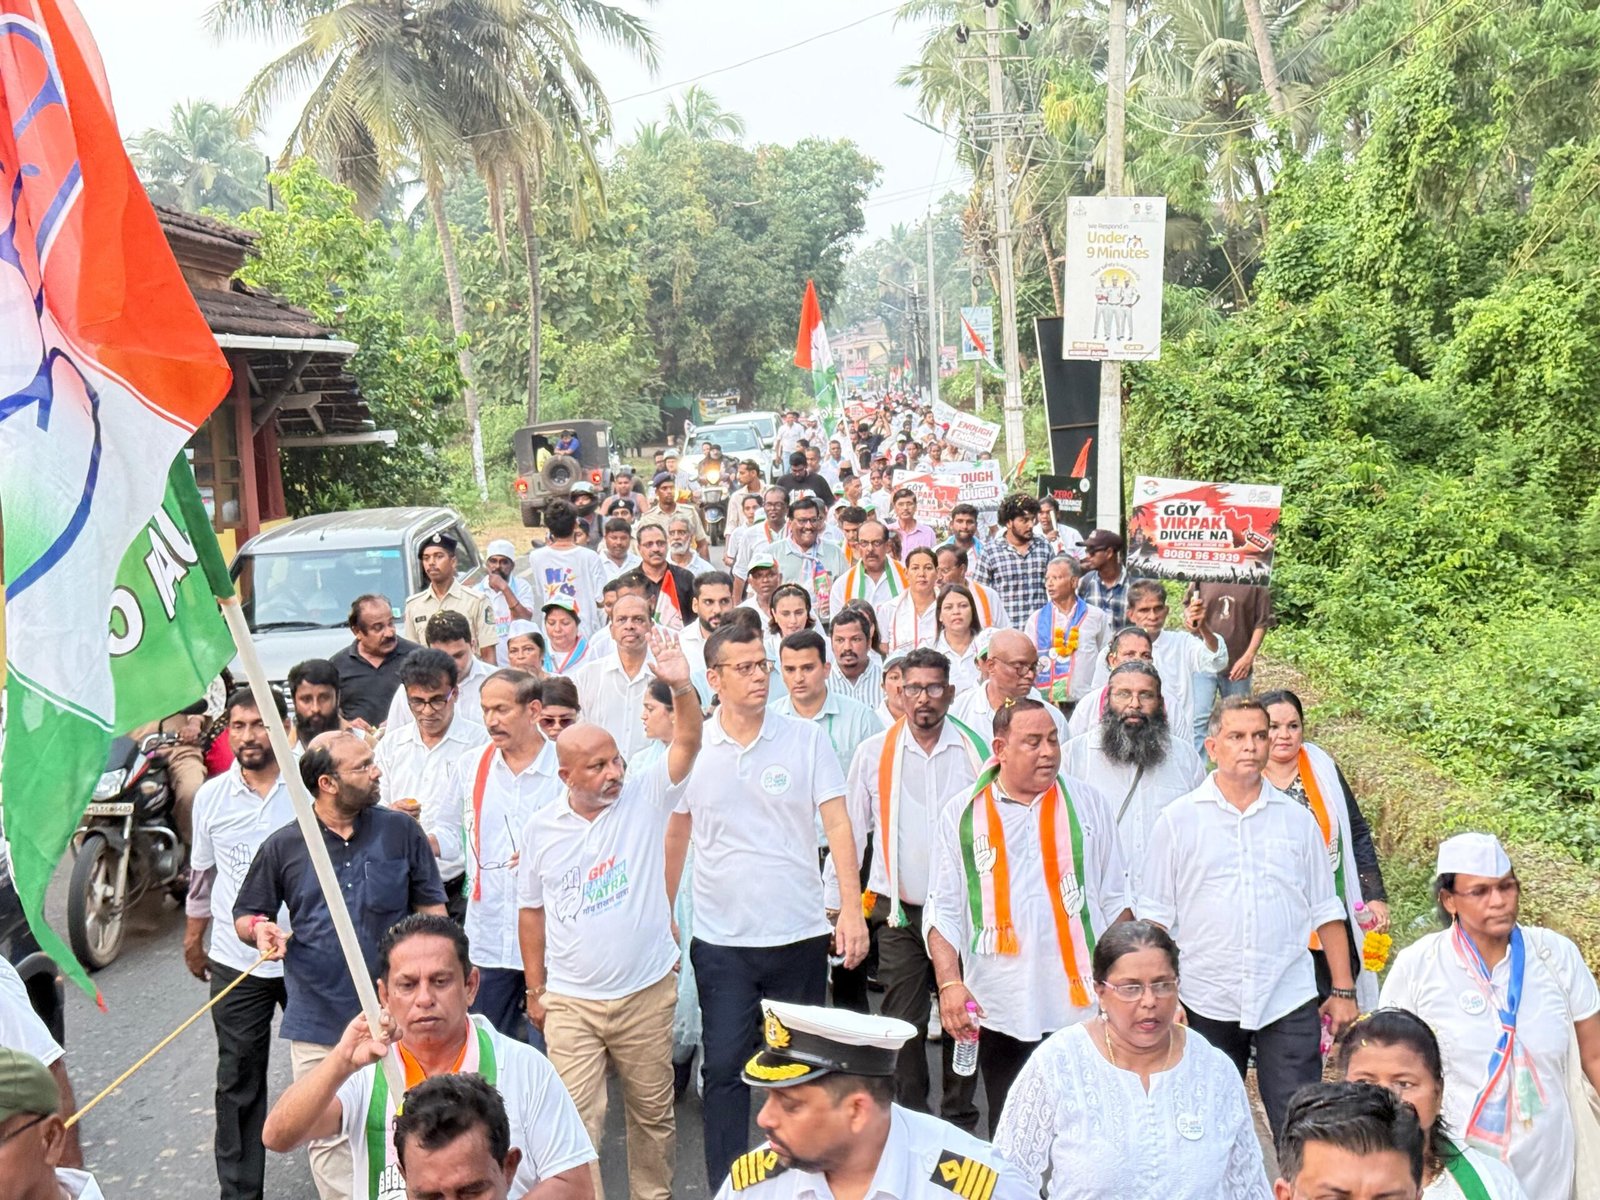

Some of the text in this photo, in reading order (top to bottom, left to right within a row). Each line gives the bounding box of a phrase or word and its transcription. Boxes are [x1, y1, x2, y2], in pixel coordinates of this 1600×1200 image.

[1087, 231, 1128, 244] Under
[1086, 245, 1150, 259] 9 Minutes
[957, 421, 993, 437] ENOUGH
[961, 471, 993, 483] OUGH
[1053, 489, 1073, 500] ZERO
[1160, 516, 1223, 530] VIKPAK
[1160, 530, 1228, 540] DIVCHE NA
[1163, 549, 1192, 559] 8080
[1195, 551, 1209, 560] 96
[1212, 552, 1240, 563] 3939
[587, 872, 629, 903] YATRA
